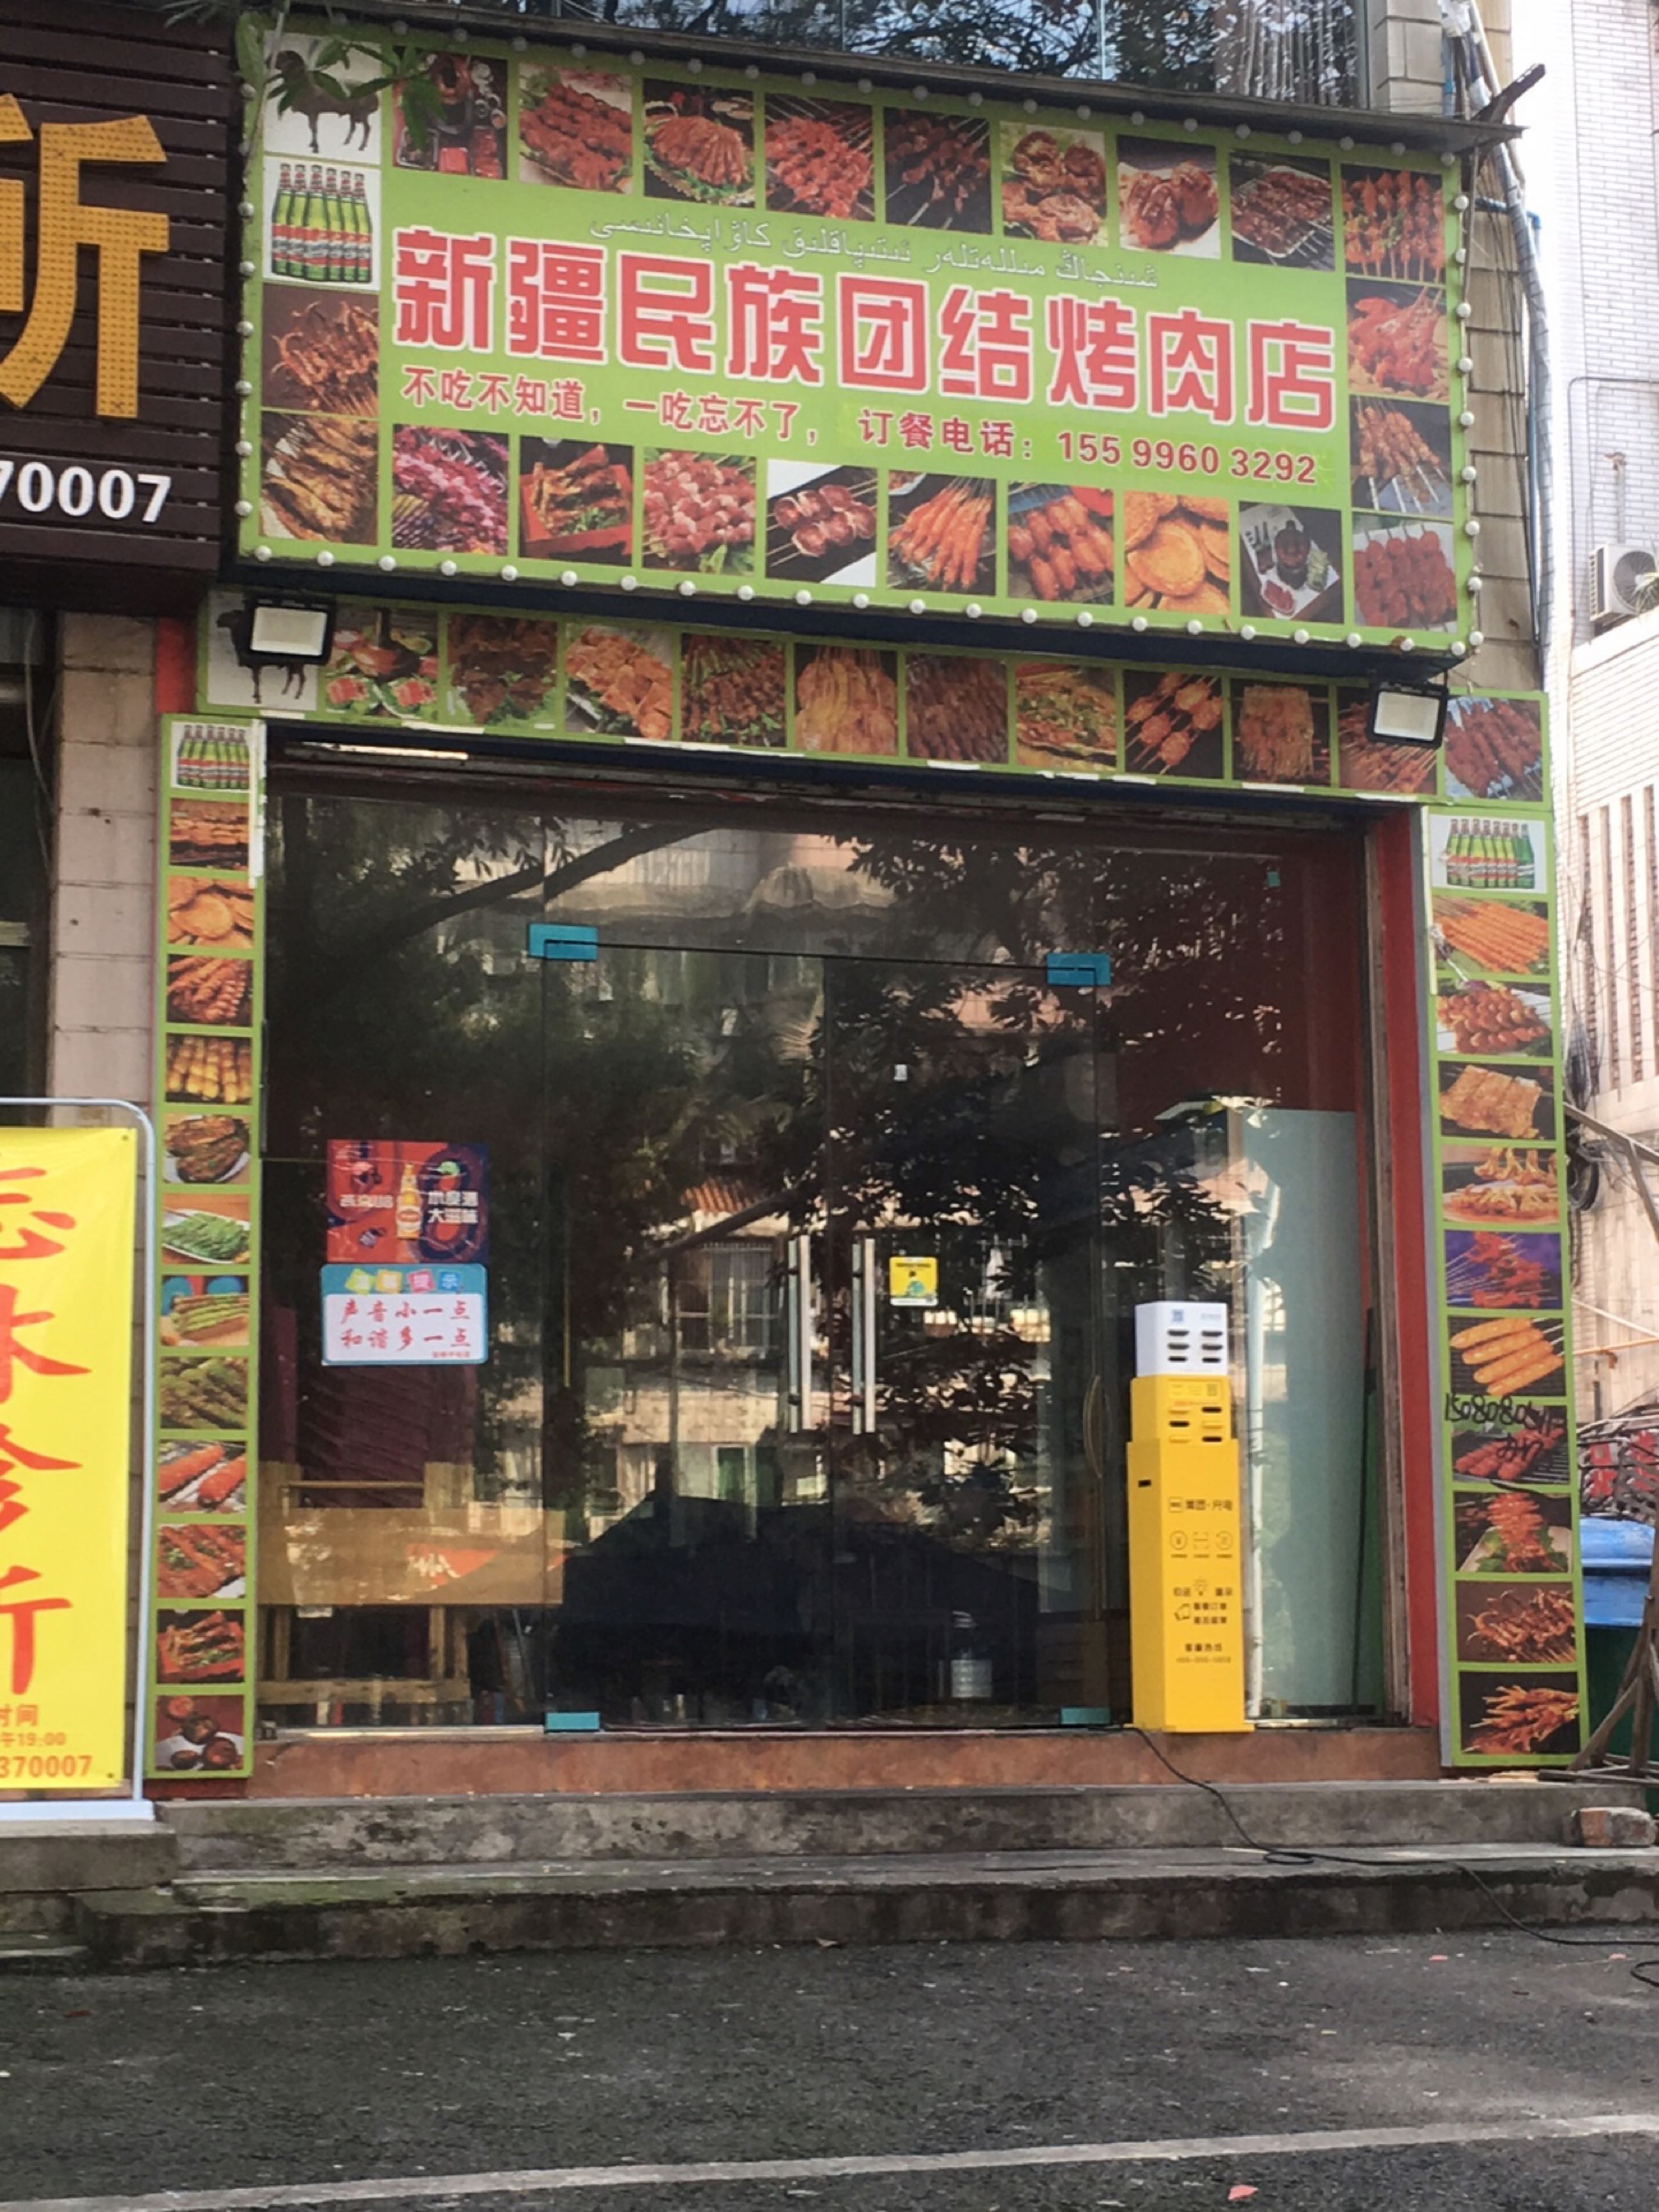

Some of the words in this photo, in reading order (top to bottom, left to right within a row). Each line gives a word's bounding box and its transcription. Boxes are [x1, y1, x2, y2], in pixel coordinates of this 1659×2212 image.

[393, 227, 1334, 431] 新疆民族团结烤肉店
[1057, 431, 1121, 465] 155
[1132, 439, 1219, 475] 9960
[1230, 449, 1317, 485] 3292
[341, 1298, 470, 1324] 声音小一点
[341, 1326, 471, 1351] 和谐多一点
